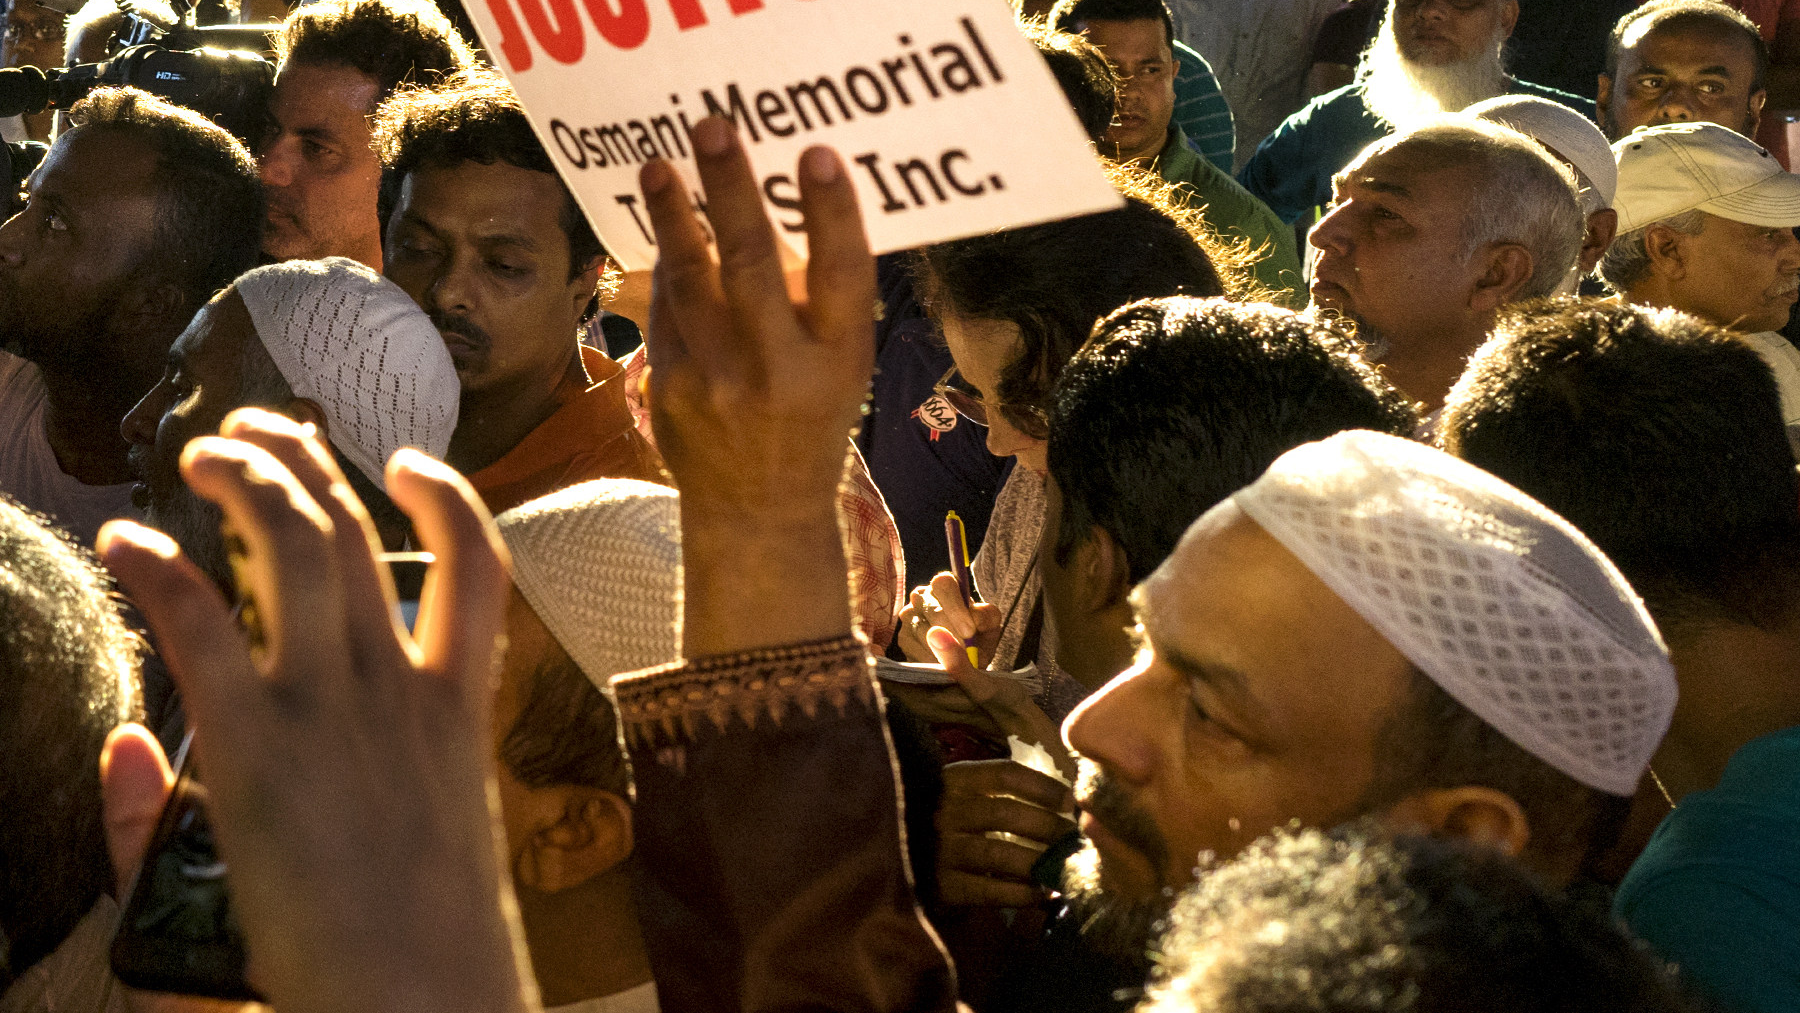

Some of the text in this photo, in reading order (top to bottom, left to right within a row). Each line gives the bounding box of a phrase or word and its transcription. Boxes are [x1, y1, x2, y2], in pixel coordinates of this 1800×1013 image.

[550, 16, 1007, 170] Osmani Memorial
[855, 148, 1007, 214] Inc.
